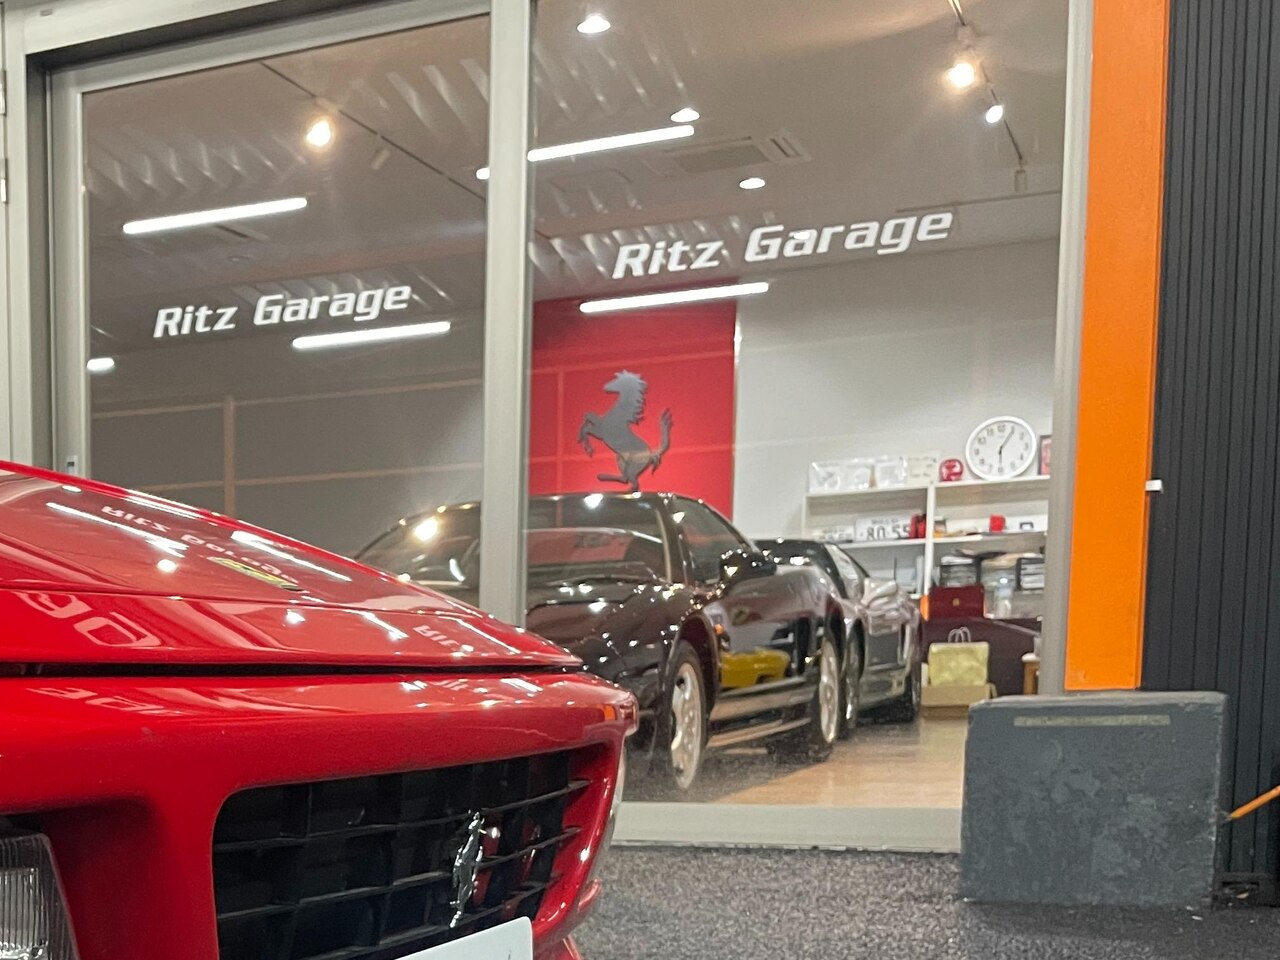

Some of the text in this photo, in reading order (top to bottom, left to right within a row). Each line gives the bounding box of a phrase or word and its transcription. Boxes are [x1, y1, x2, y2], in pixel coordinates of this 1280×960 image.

[612, 211, 954, 280] Ritz Garage
[153, 284, 413, 338] Ritz Garage
